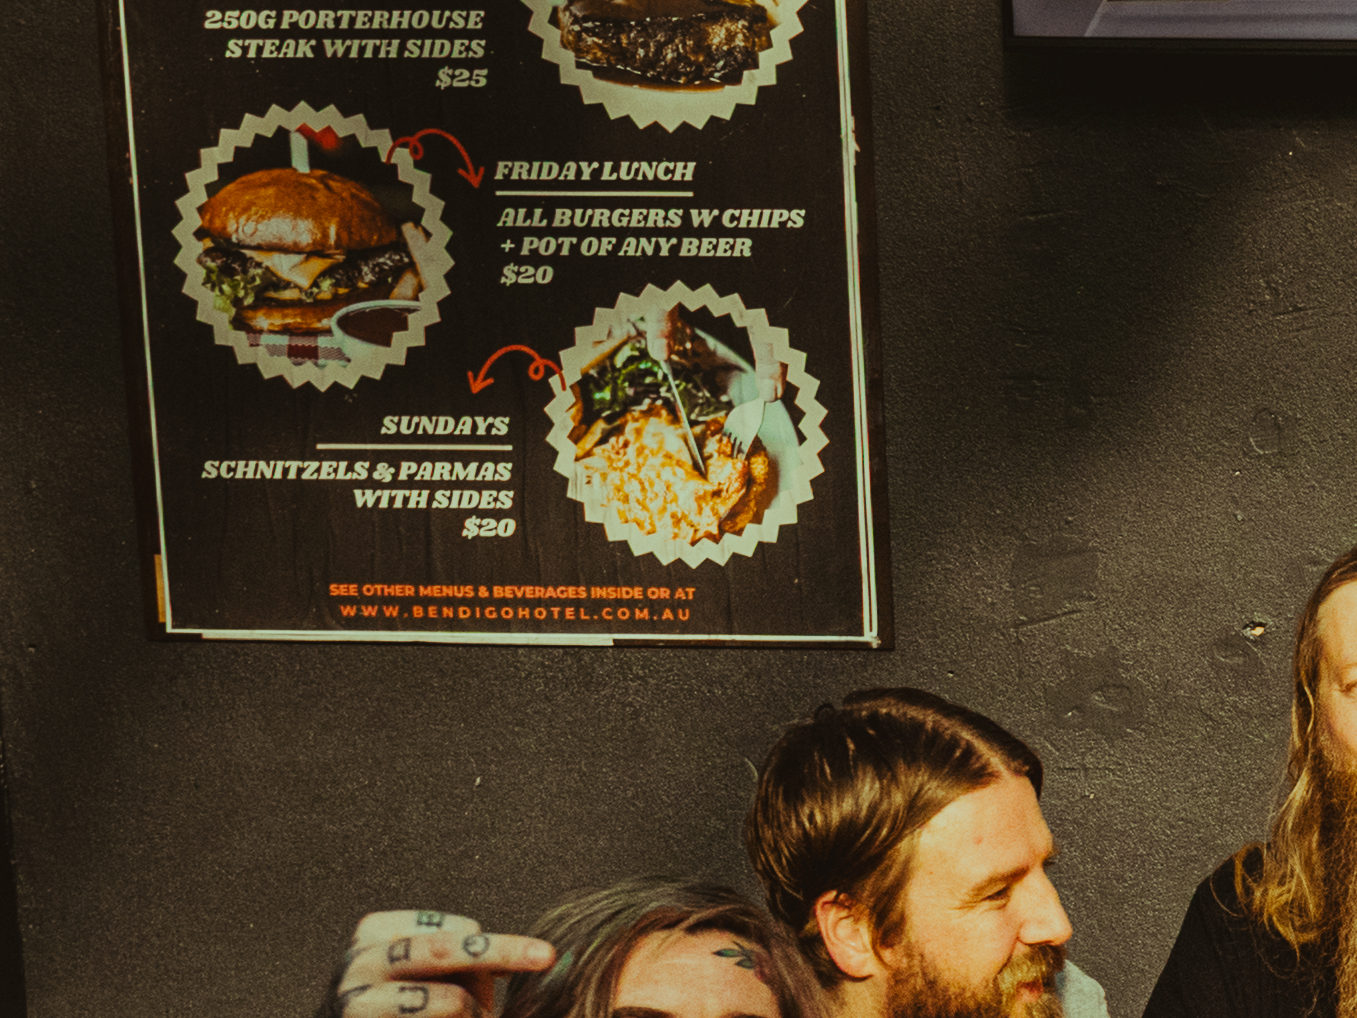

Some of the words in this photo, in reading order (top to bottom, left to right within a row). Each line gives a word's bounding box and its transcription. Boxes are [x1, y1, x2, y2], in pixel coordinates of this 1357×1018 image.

[203, 9, 277, 31] 250G
[279, 9, 486, 31] PORTERHOUSE
[223, 38, 317, 59] STEAK
[321, 38, 402, 59] WITH
[403, 38, 487, 59] SIDES
[434, 65, 489, 91] $25
[493, 160, 601, 182] FRIDAY
[599, 160, 698, 182] LUNCH
[495, 207, 549, 229] ALL
[551, 207, 685, 229] BURGERS
[688, 207, 721, 229] W
[721, 207, 807, 229] CHIPS
[499, 238, 517, 254] +
[519, 236, 579, 257] POT
[579, 236, 618, 257] OF
[617, 236, 679, 257] ANY
[678, 236, 754, 258] BEER
[499, 262, 555, 288] $20
[379, 414, 511, 437] SUNDAYS
[200, 459, 371, 482] SCHNITZELS
[371, 461, 396, 483] &
[396, 460, 514, 482] PARMAS
[352, 488, 432, 510] WITH
[431, 488, 516, 511] SIDES
[460, 514, 518, 541] $20
[328, 582, 360, 598] SEE
[361, 582, 417, 598] OTHER
[418, 583, 475, 599] MENUS
[476, 584, 491, 600] &
[491, 584, 589, 600] BEVERAGES
[589, 585, 645, 601] INSIDE
[647, 586, 672, 601] OR
[673, 586, 697, 601] AT
[339, 604, 691, 622] WWW.BENDIGOHOTEL.COM.AU
